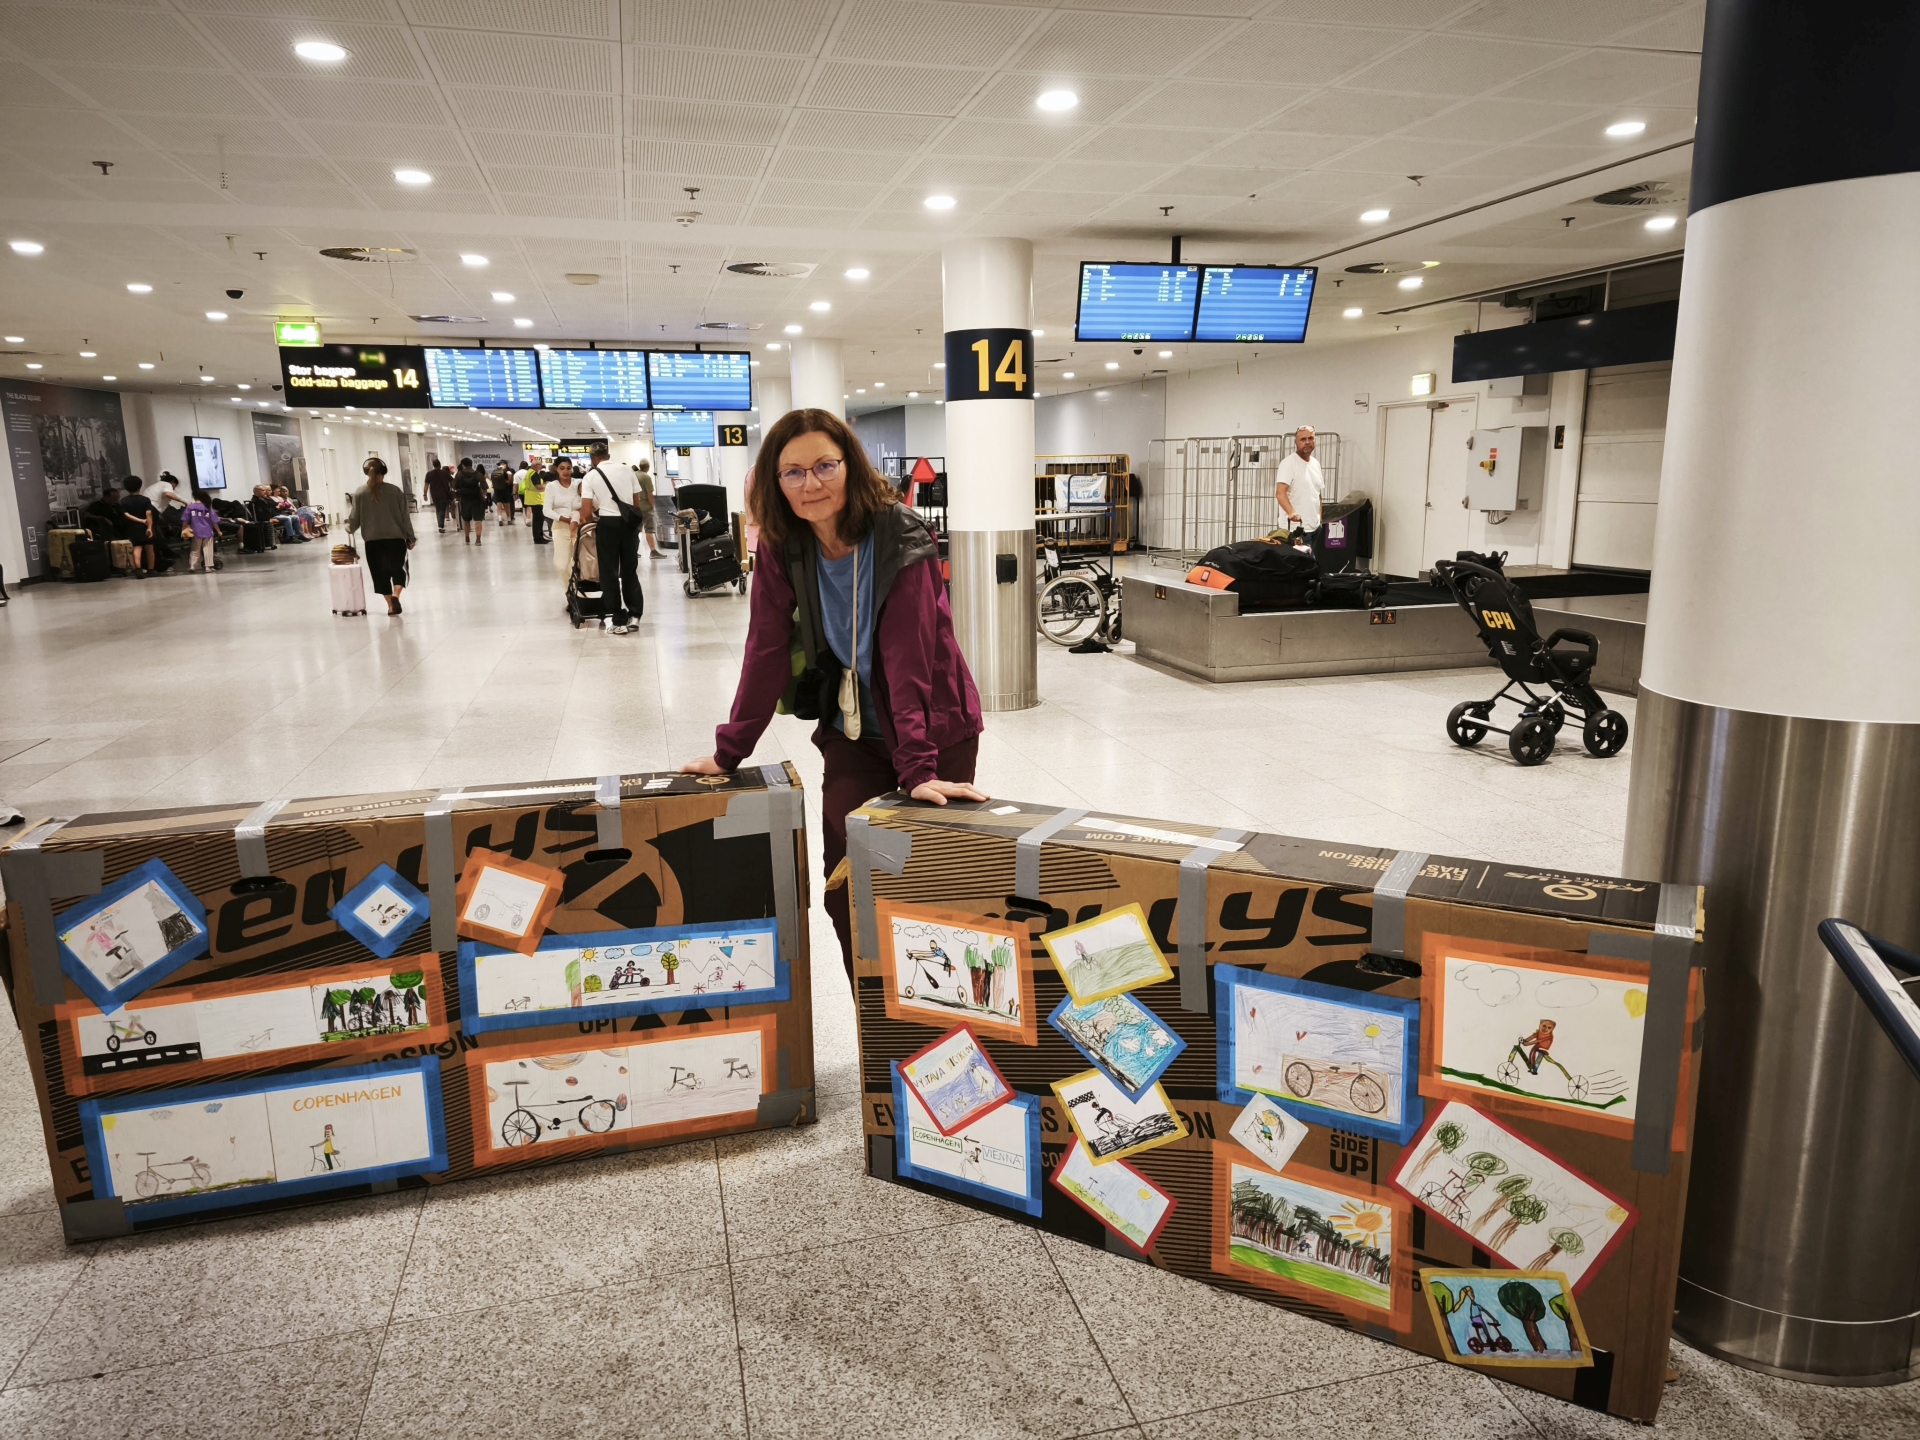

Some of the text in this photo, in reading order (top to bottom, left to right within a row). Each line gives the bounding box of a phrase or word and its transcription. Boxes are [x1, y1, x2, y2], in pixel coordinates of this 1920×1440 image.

[288, 364, 356, 378] Stor bagage
[971, 339, 1027, 391] 14
[290, 377, 388, 390] Odd-size baggage
[393, 368, 419, 388] 14
[724, 427, 743, 444] 13
[1482, 609, 1516, 631] CPH
[1426, 863, 1469, 875] HAS
[292, 1085, 403, 1112] COPENHAGEN
[914, 1129, 962, 1149] COPENHAGEN
[1330, 1133, 1369, 1156] SIDE
[983, 1147, 1022, 1166] VIENNA
[1329, 1149, 1369, 1177] UP
